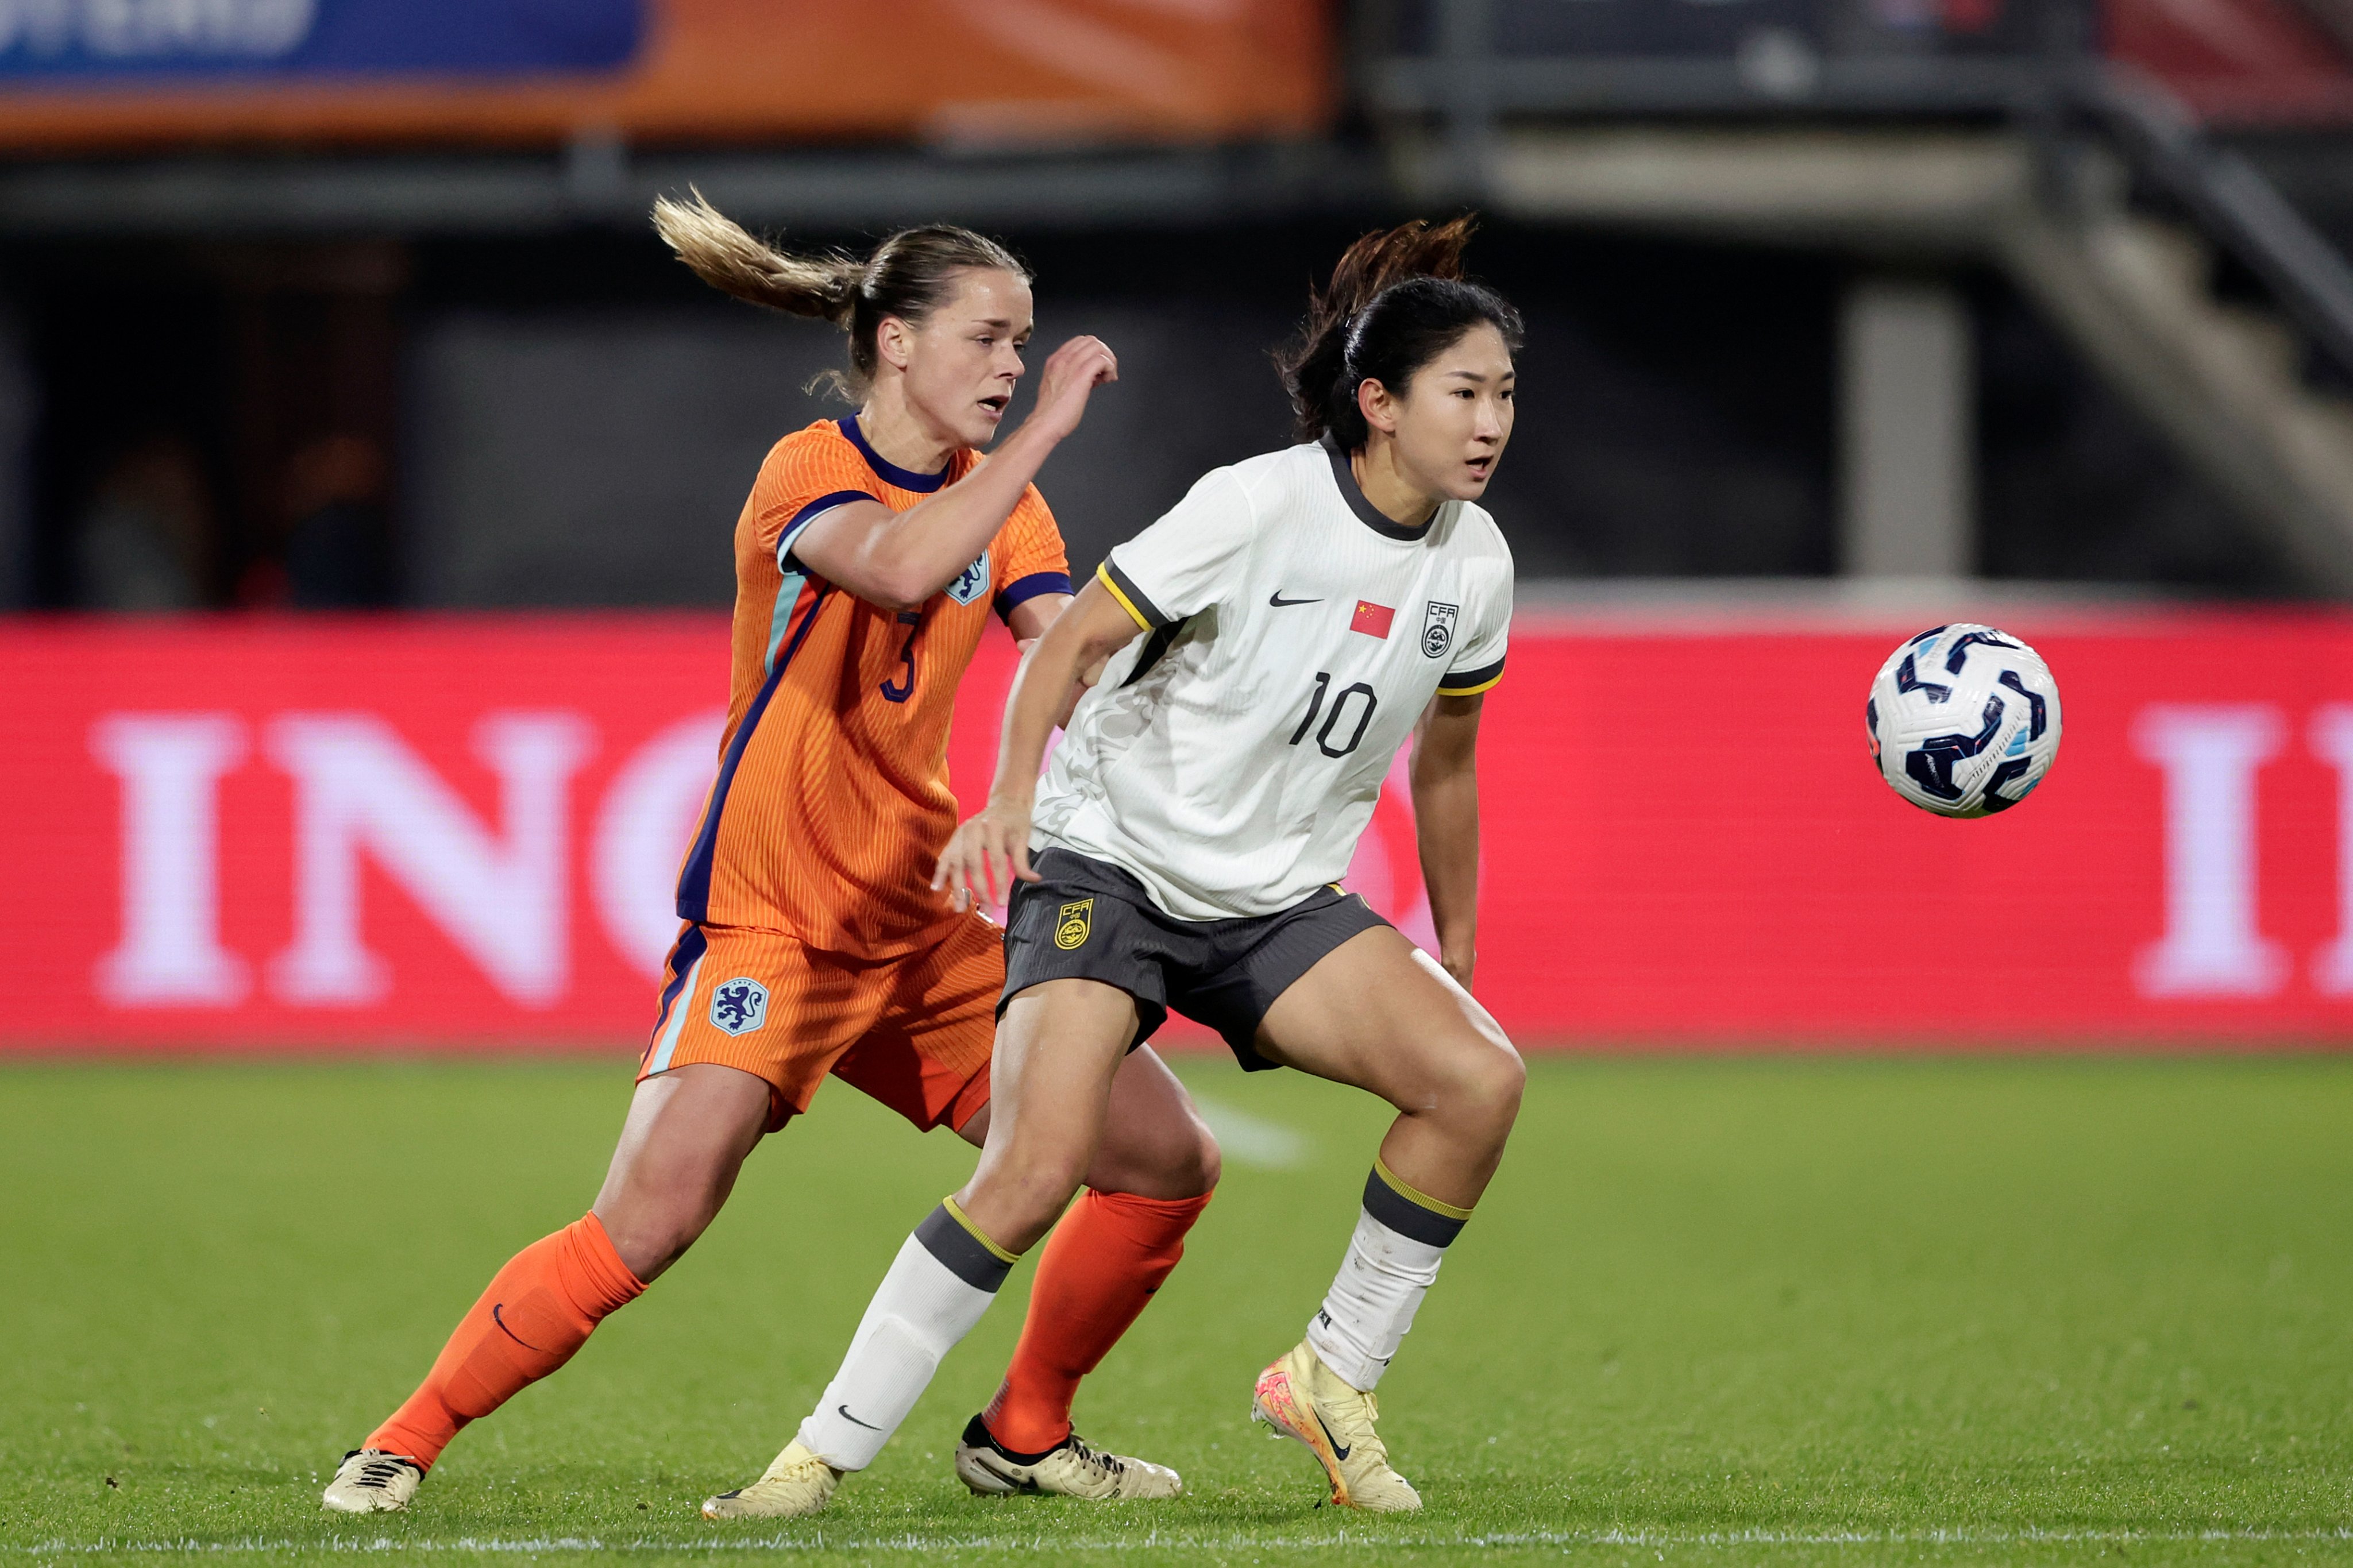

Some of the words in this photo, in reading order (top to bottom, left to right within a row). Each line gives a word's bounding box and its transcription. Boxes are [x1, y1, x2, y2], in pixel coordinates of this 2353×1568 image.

[1429, 605, 1456, 618] CFA
[880, 611, 921, 704] 3
[1289, 671, 1378, 759] 10
[1063, 902, 1090, 916] CFA
